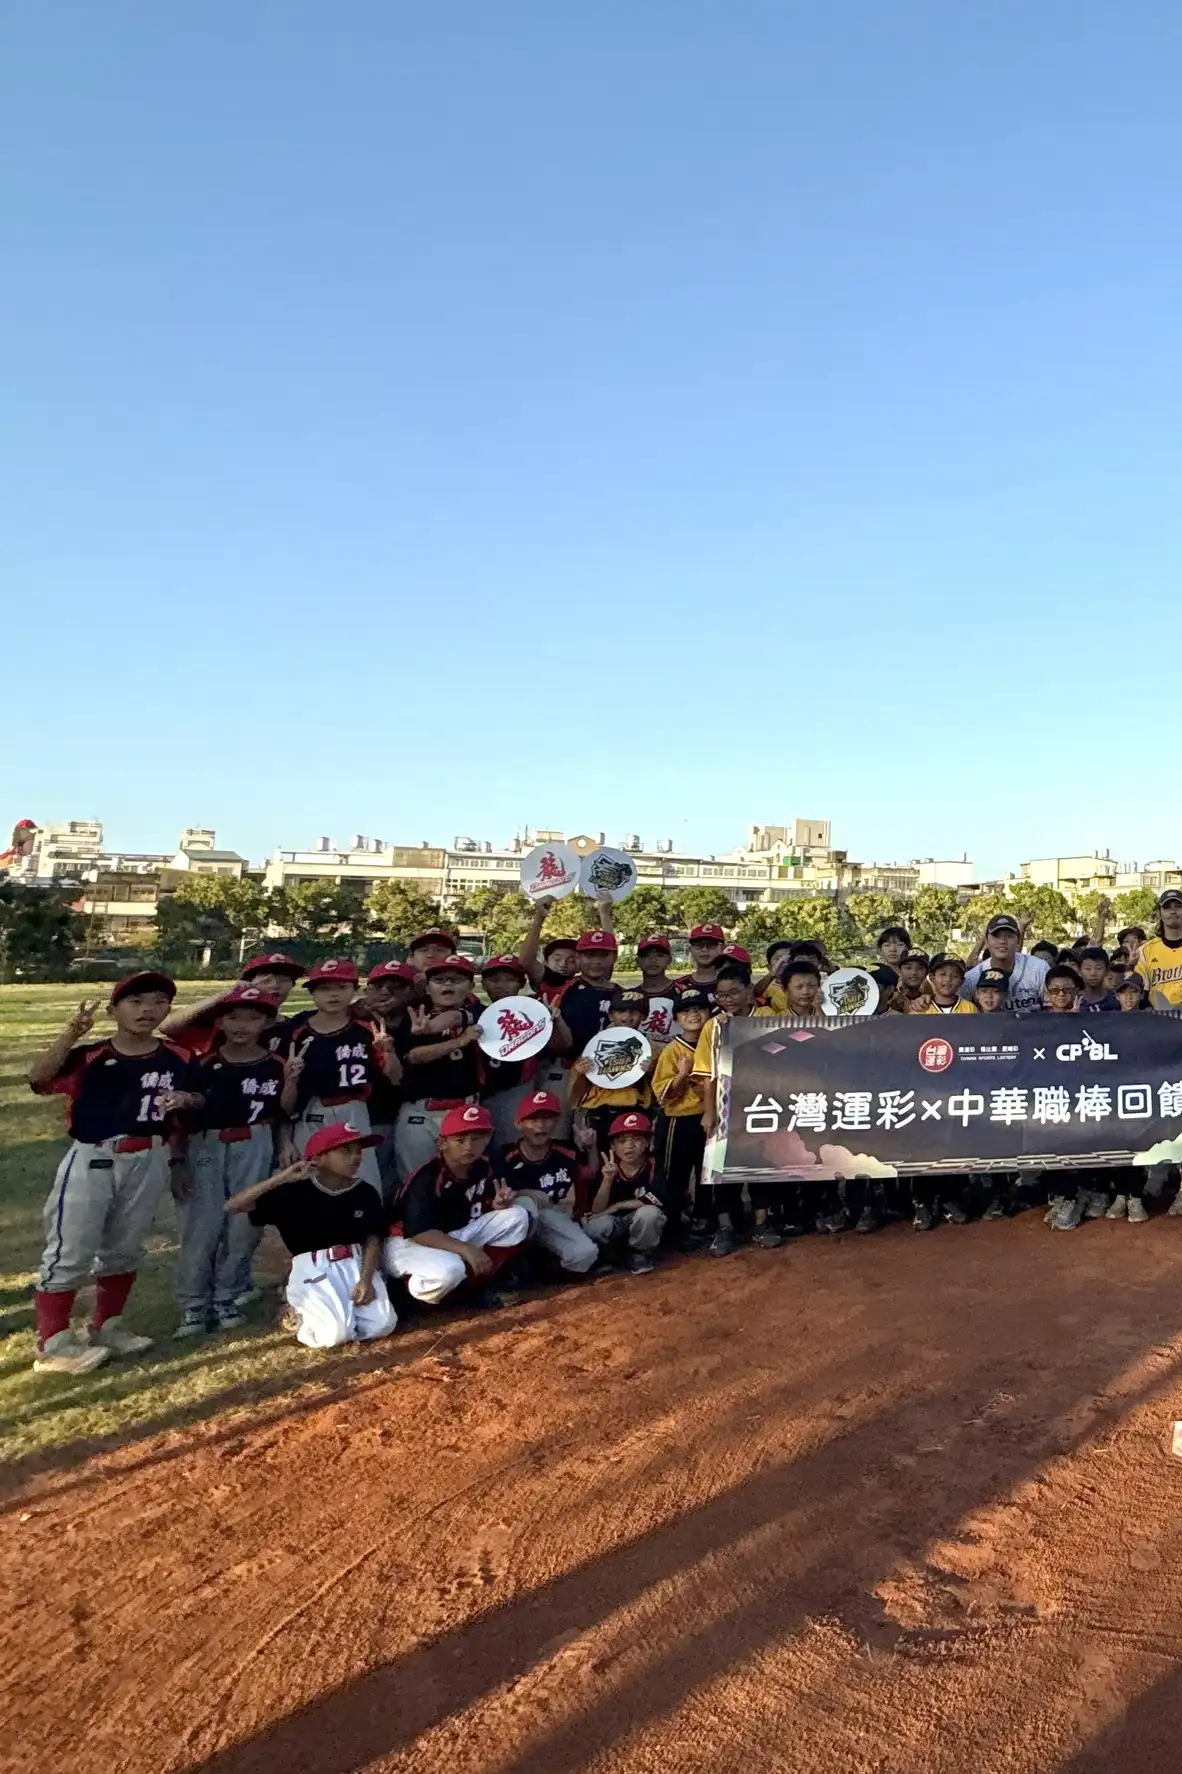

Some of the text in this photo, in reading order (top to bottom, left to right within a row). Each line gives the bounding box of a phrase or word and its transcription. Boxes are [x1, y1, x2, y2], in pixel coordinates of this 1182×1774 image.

[1056, 1043, 1118, 1062] CPBL
[339, 1064, 367, 1088] 12
[248, 1100, 264, 1124] 7
[463, 1107, 479, 1121] C
